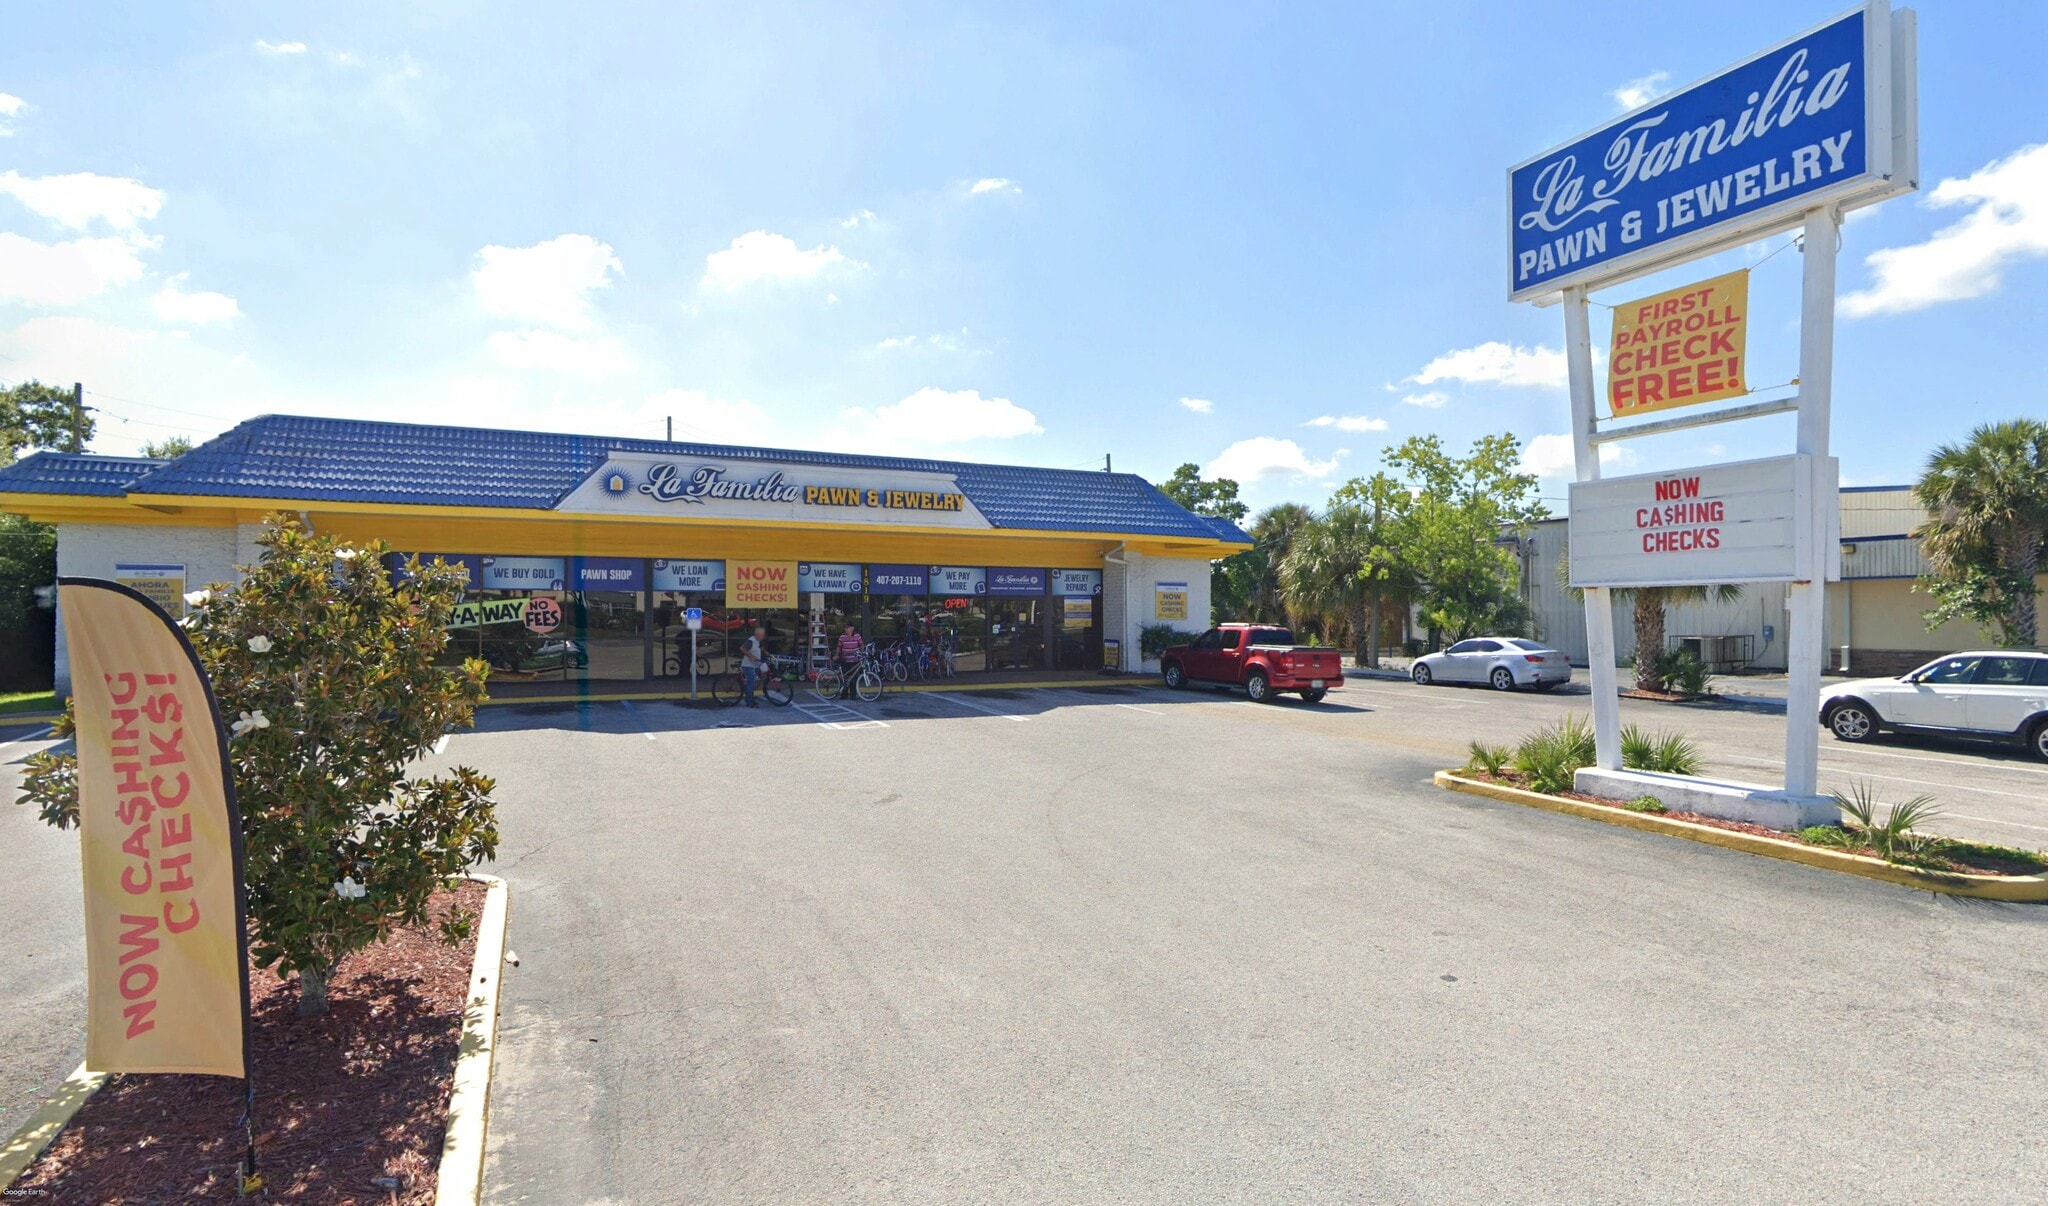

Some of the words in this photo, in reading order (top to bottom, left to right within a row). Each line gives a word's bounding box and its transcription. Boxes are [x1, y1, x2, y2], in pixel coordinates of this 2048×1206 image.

[1519, 155, 1620, 232] La
[1592, 48, 1851, 198] Familia
[1519, 222, 1607, 281] PAWN
[1620, 210, 1642, 244] &
[1656, 130, 1852, 234] JEWELRY
[1638, 288, 1714, 324] FIRST
[1616, 305, 1741, 350] PAYROLL
[1613, 327, 1737, 376] CHECK
[1613, 356, 1739, 409] FREE!
[639, 463, 704, 504] La
[687, 465, 799, 502] Familia
[1655, 476, 1700, 501] NOW
[804, 486, 861, 505] PAWN
[866, 489, 879, 507] &
[883, 489, 966, 511] JEWELRY
[1636, 501, 1724, 528] CA$HING
[1642, 528, 1720, 553] CHECKS
[493, 567, 509, 579] WE
[512, 568, 528, 579] BUY
[532, 568, 554, 579] GOLD
[581, 569, 608, 580] PAWN
[610, 569, 632, 580] SHOP
[672, 565, 685, 575] WE
[688, 566, 708, 576] LOAN
[737, 566, 787, 581] NOW
[814, 569, 827, 578] WE
[828, 569, 846, 579] HAVE
[946, 571, 957, 580] WE
[958, 571, 970, 581] PAY
[1064, 573, 1089, 582] JEWELRY
[679, 576, 701, 587] MORE
[813, 579, 847, 589] LAYAWAY
[876, 575, 922, 586] 407-207-1110
[949, 581, 967, 591] MORE
[1066, 583, 1088, 592] REPAIRS
[530, 601, 548, 611] NO
[944, 597, 967, 609] OPEN
[525, 610, 559, 627] FEES
[104, 672, 156, 895] CA$HING
[141, 672, 200, 934] CHECK$!
[119, 913, 160, 1041] NOW
